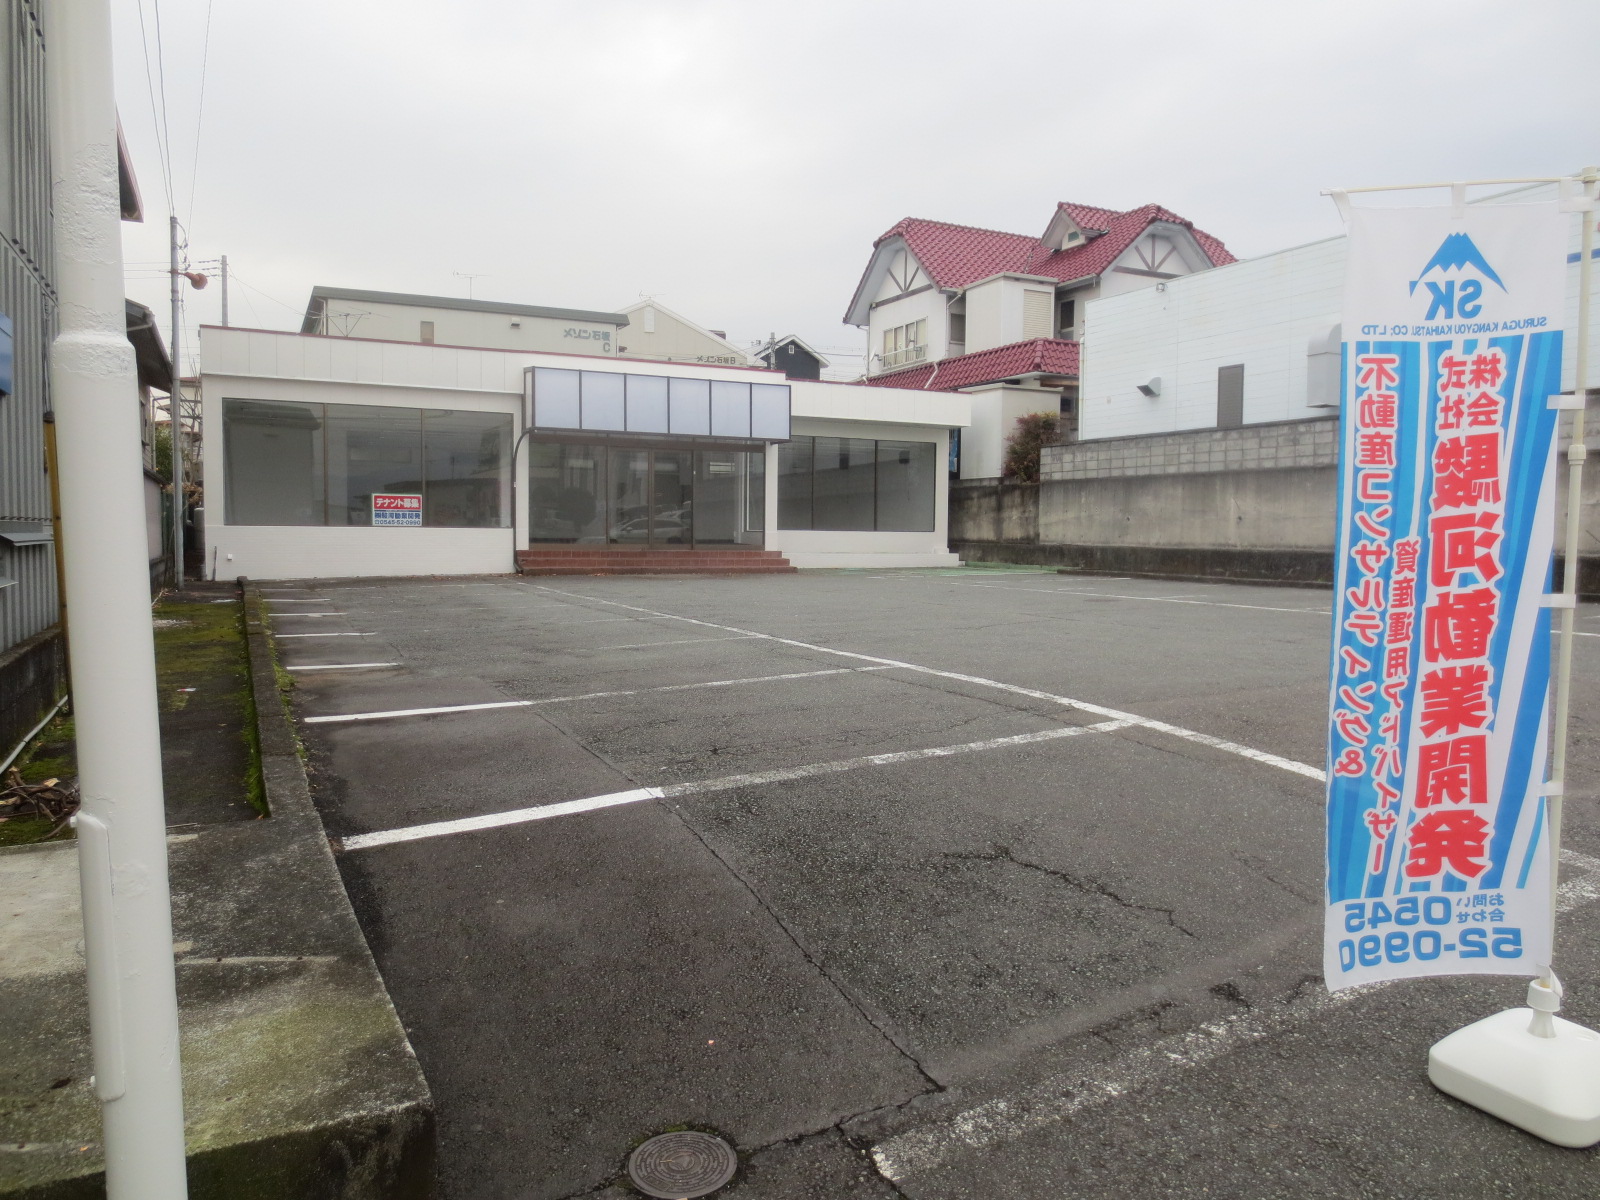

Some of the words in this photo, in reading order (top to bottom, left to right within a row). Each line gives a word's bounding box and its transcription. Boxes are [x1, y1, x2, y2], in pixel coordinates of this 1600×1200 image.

[376, 497, 420, 508] テナント募集
